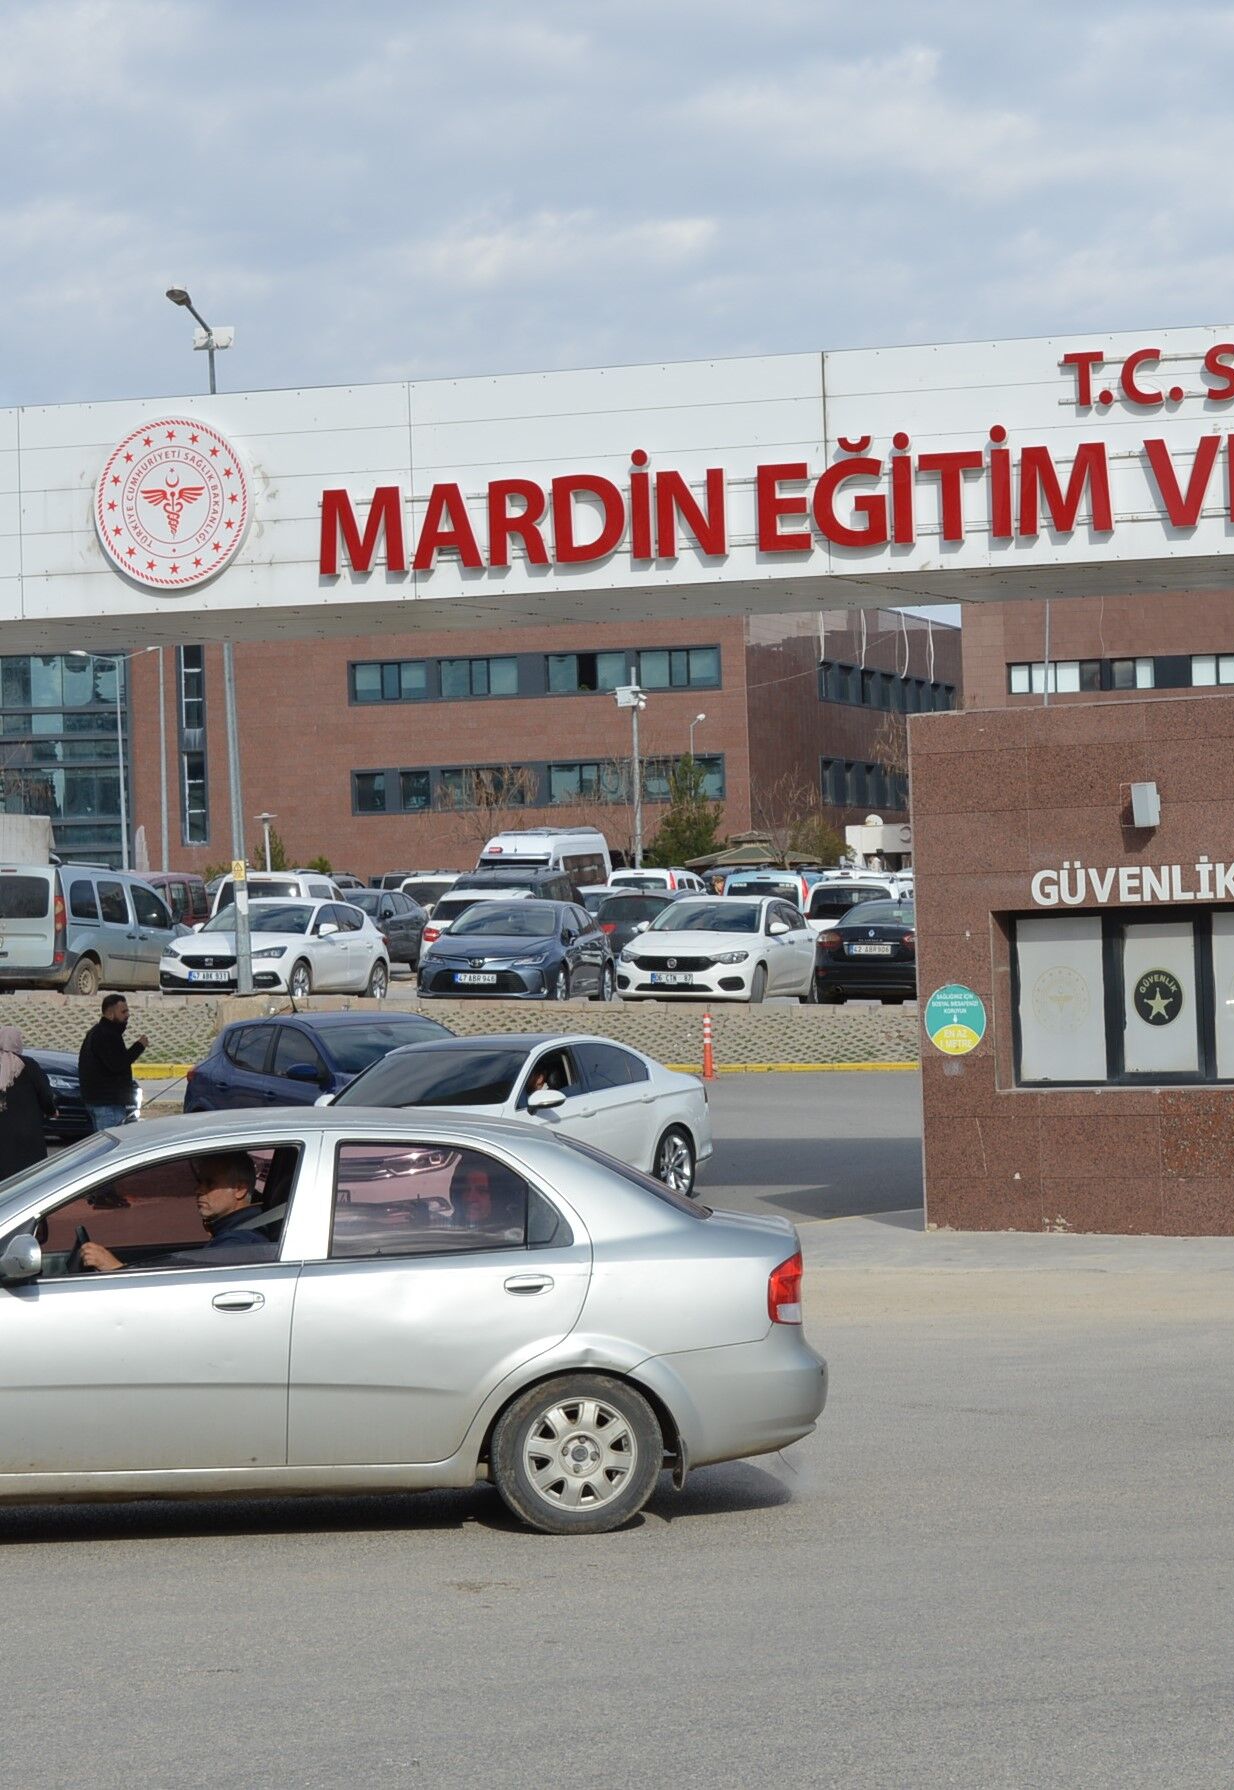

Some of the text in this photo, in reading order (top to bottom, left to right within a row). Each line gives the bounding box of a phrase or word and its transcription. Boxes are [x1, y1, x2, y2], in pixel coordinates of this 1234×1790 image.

[1063, 350, 1185, 407] T.C.
[319, 449, 728, 576] MARDİN
[756, 425, 1114, 553] EĞİTİM
